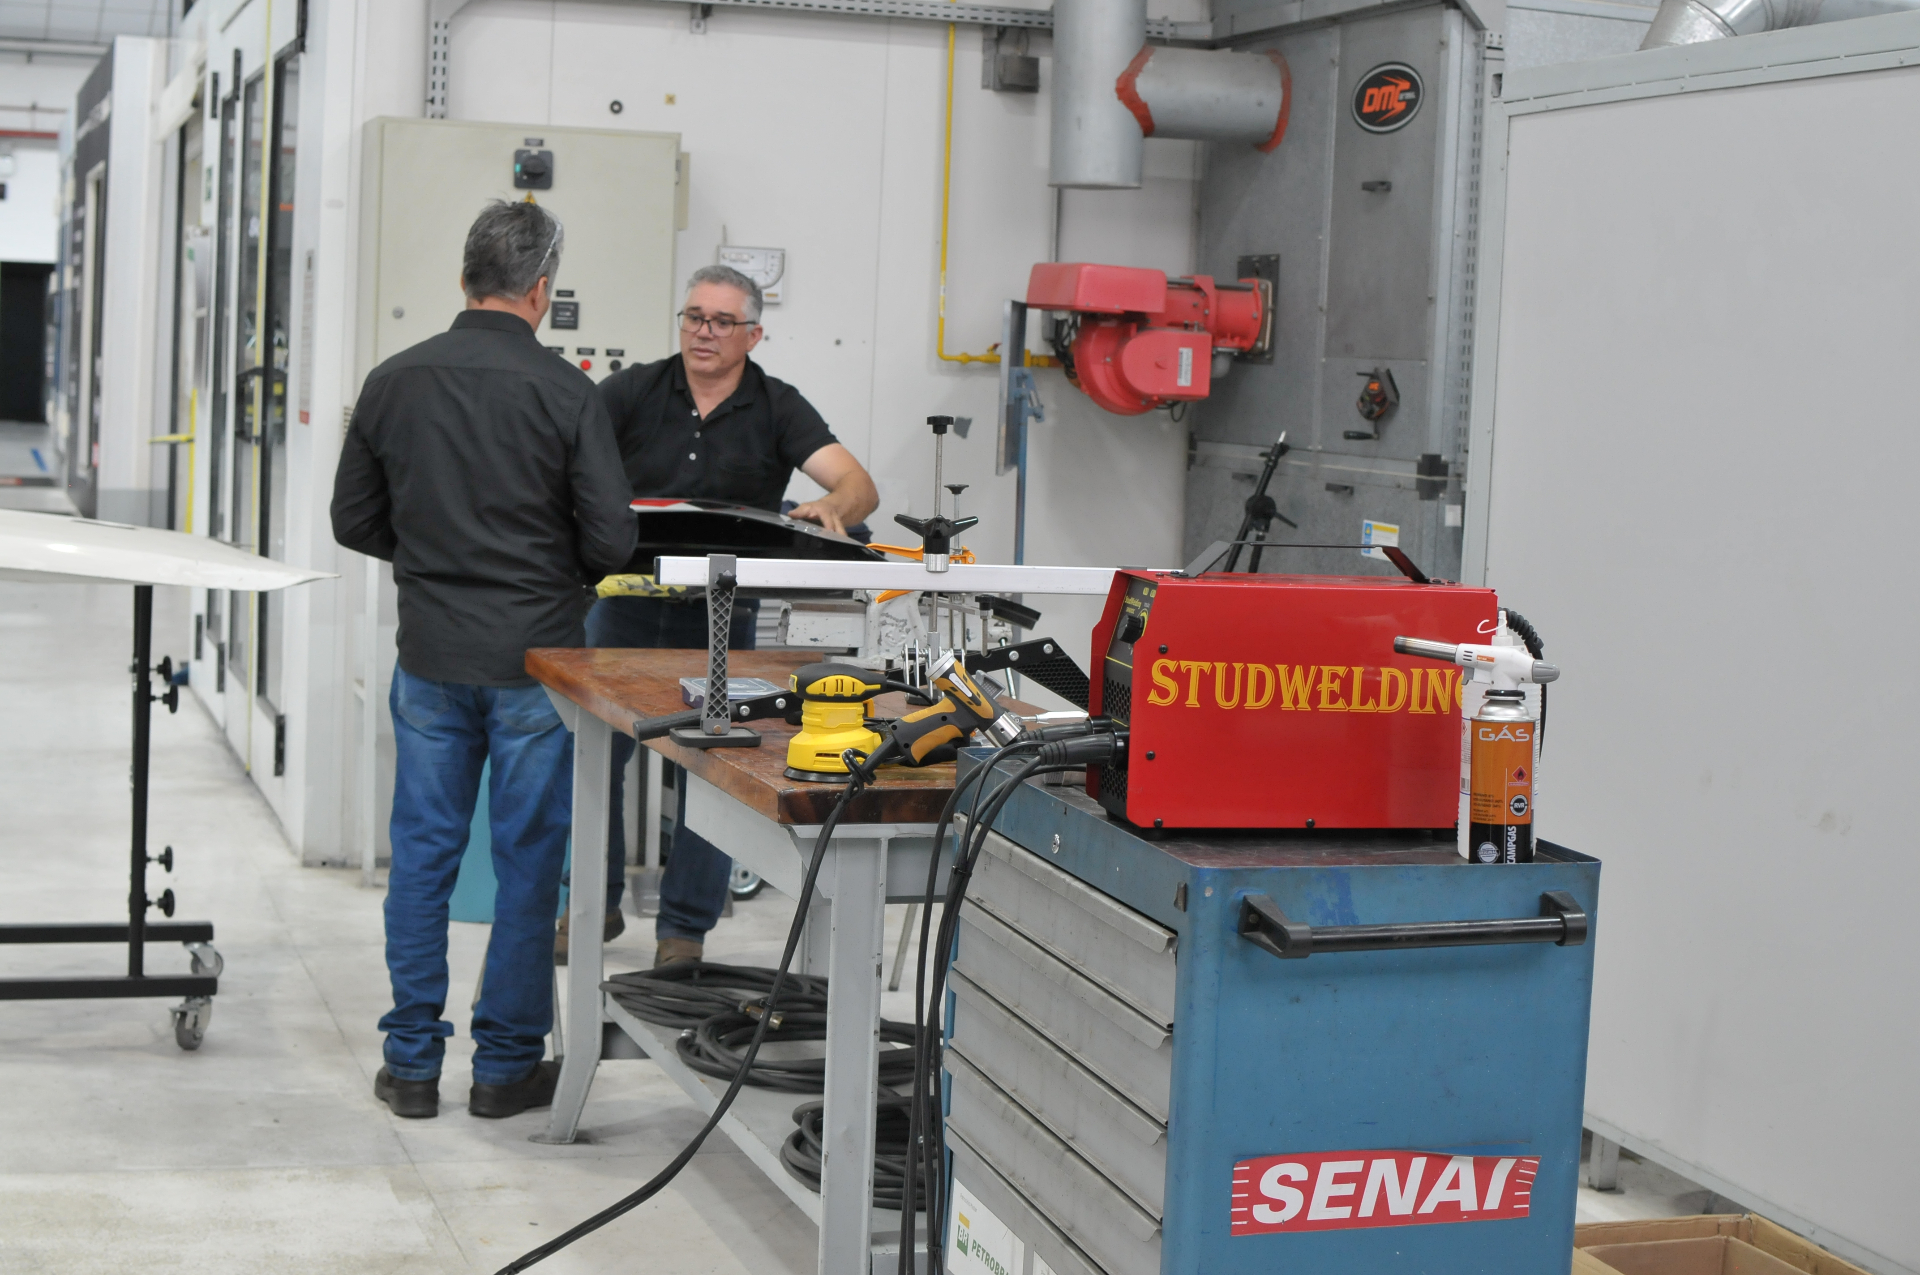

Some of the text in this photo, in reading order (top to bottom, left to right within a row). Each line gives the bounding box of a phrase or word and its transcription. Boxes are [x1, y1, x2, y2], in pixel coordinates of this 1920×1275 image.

[1147, 658, 1464, 714] STUDWELDIN
[1479, 725, 1530, 742] GÁS
[1507, 825, 1517, 864] CAMPGAS
[1252, 1155, 1517, 1224] SENAI
